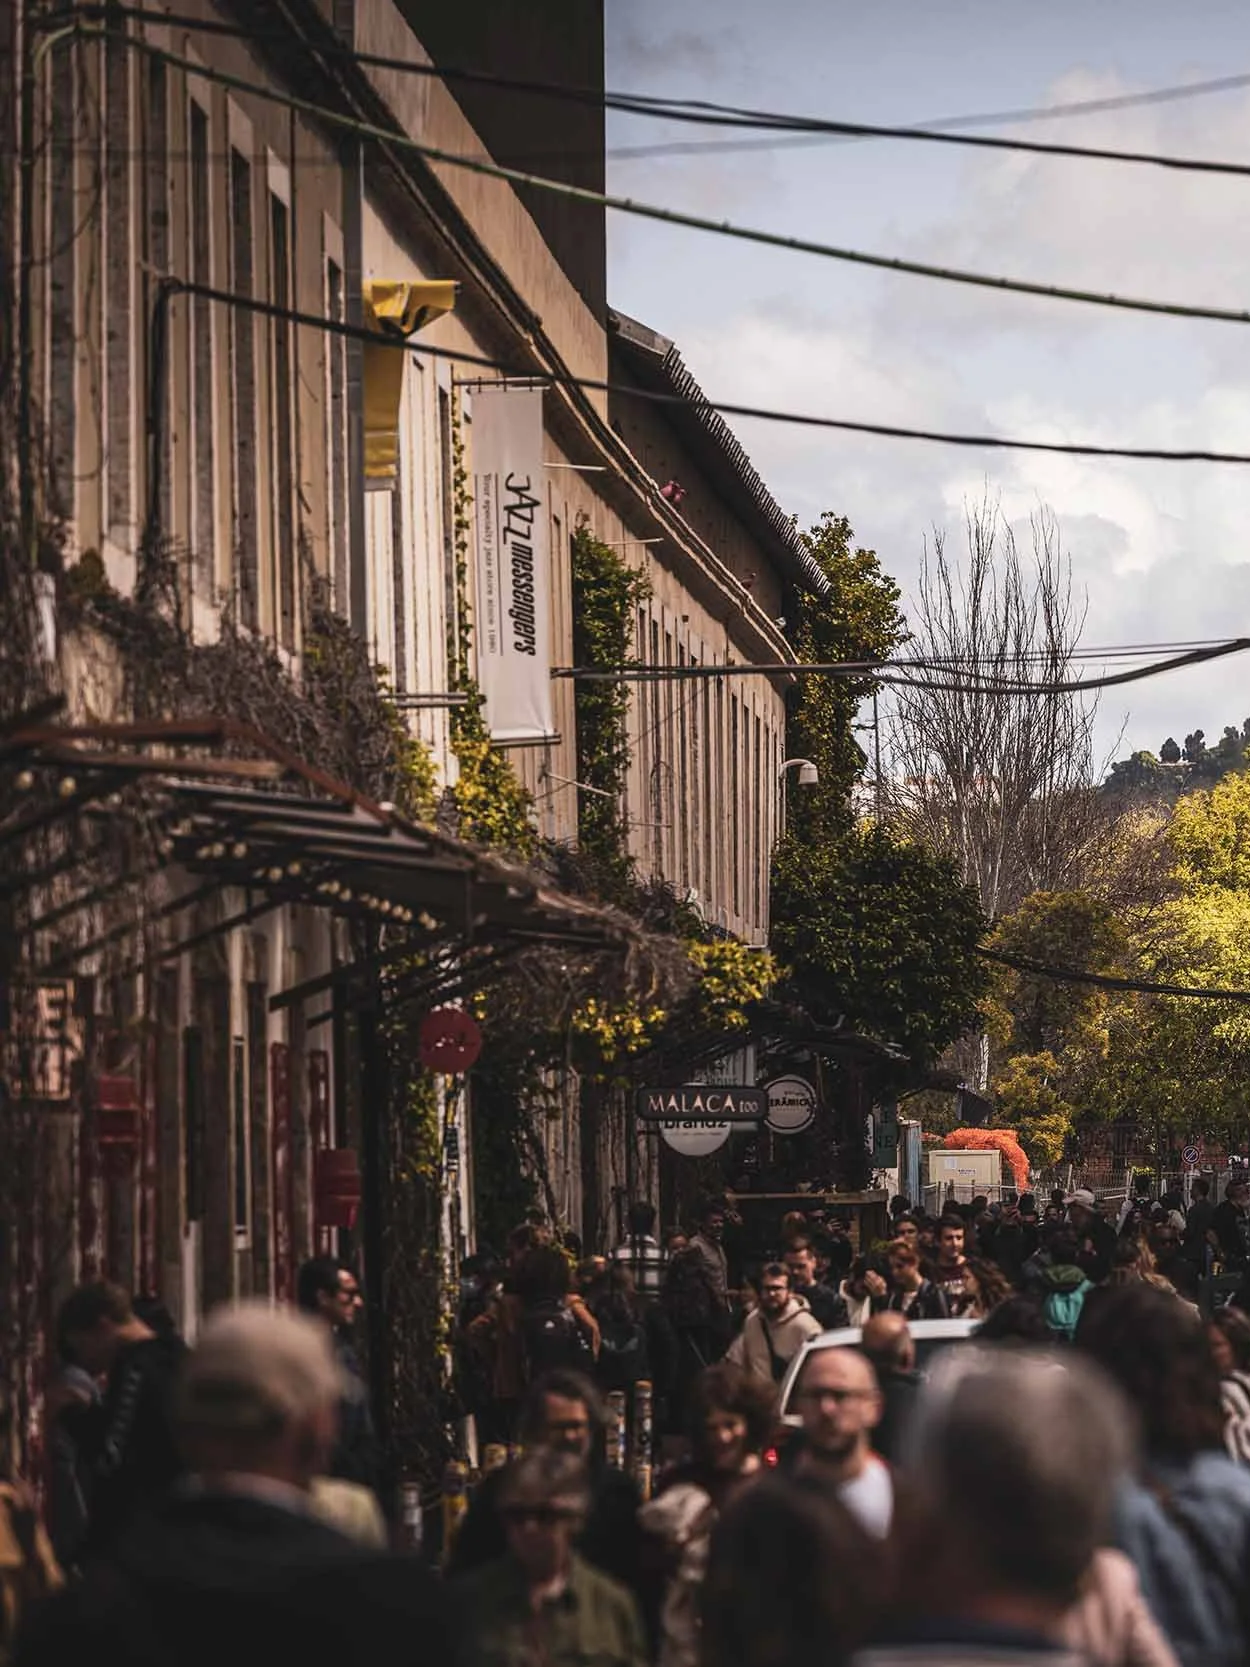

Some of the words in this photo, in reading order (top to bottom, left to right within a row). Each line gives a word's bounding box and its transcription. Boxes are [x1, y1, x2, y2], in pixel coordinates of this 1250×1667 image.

[482, 500, 494, 544] specialty
[503, 472, 542, 545] JAZZ
[486, 570, 495, 596] store
[509, 541, 536, 657] messengers
[487, 599, 496, 625] since
[649, 1093, 736, 1112] MALACA
[739, 1101, 759, 1113] too
